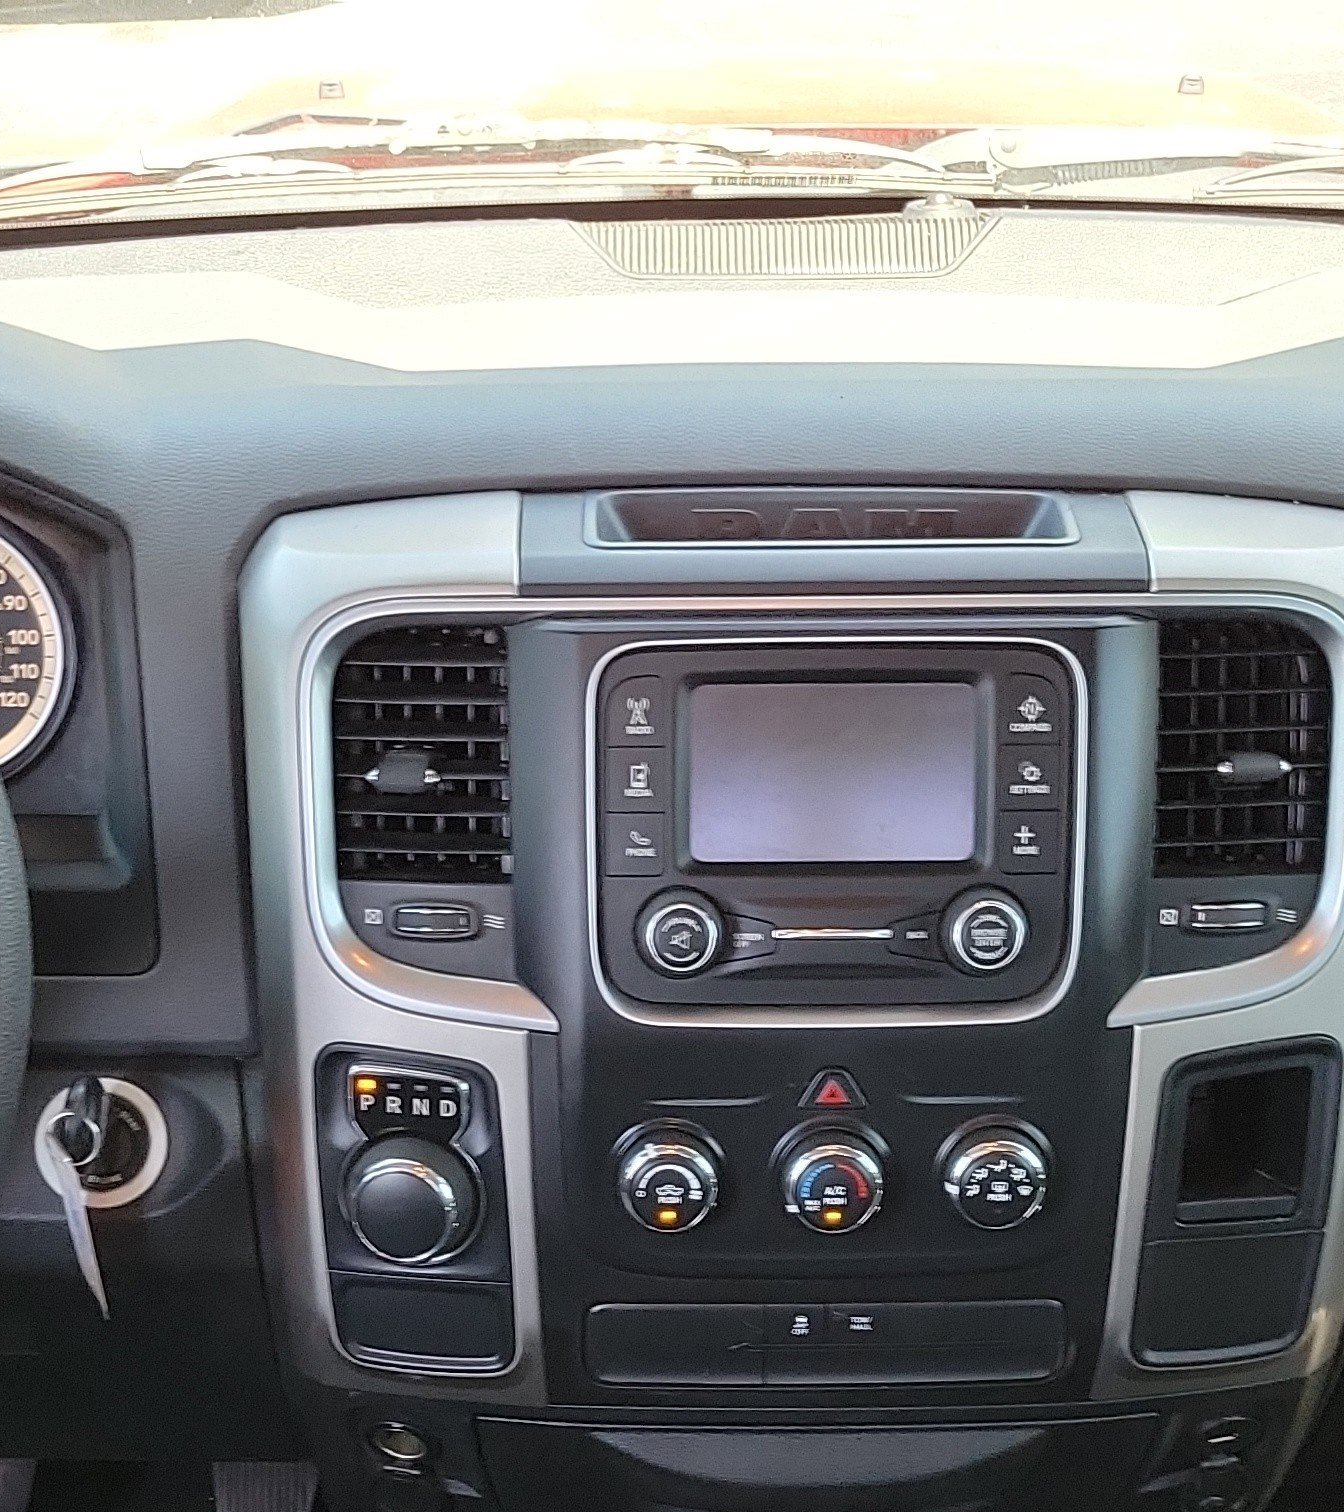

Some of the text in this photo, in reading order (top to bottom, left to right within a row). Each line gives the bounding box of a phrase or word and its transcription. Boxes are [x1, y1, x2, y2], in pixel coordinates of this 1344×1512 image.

[3, 595, 29, 611] 90
[6, 629, 40, 645] 100
[9, 664, 40, 679] 110
[359, 1094, 457, 1117] P R N D
